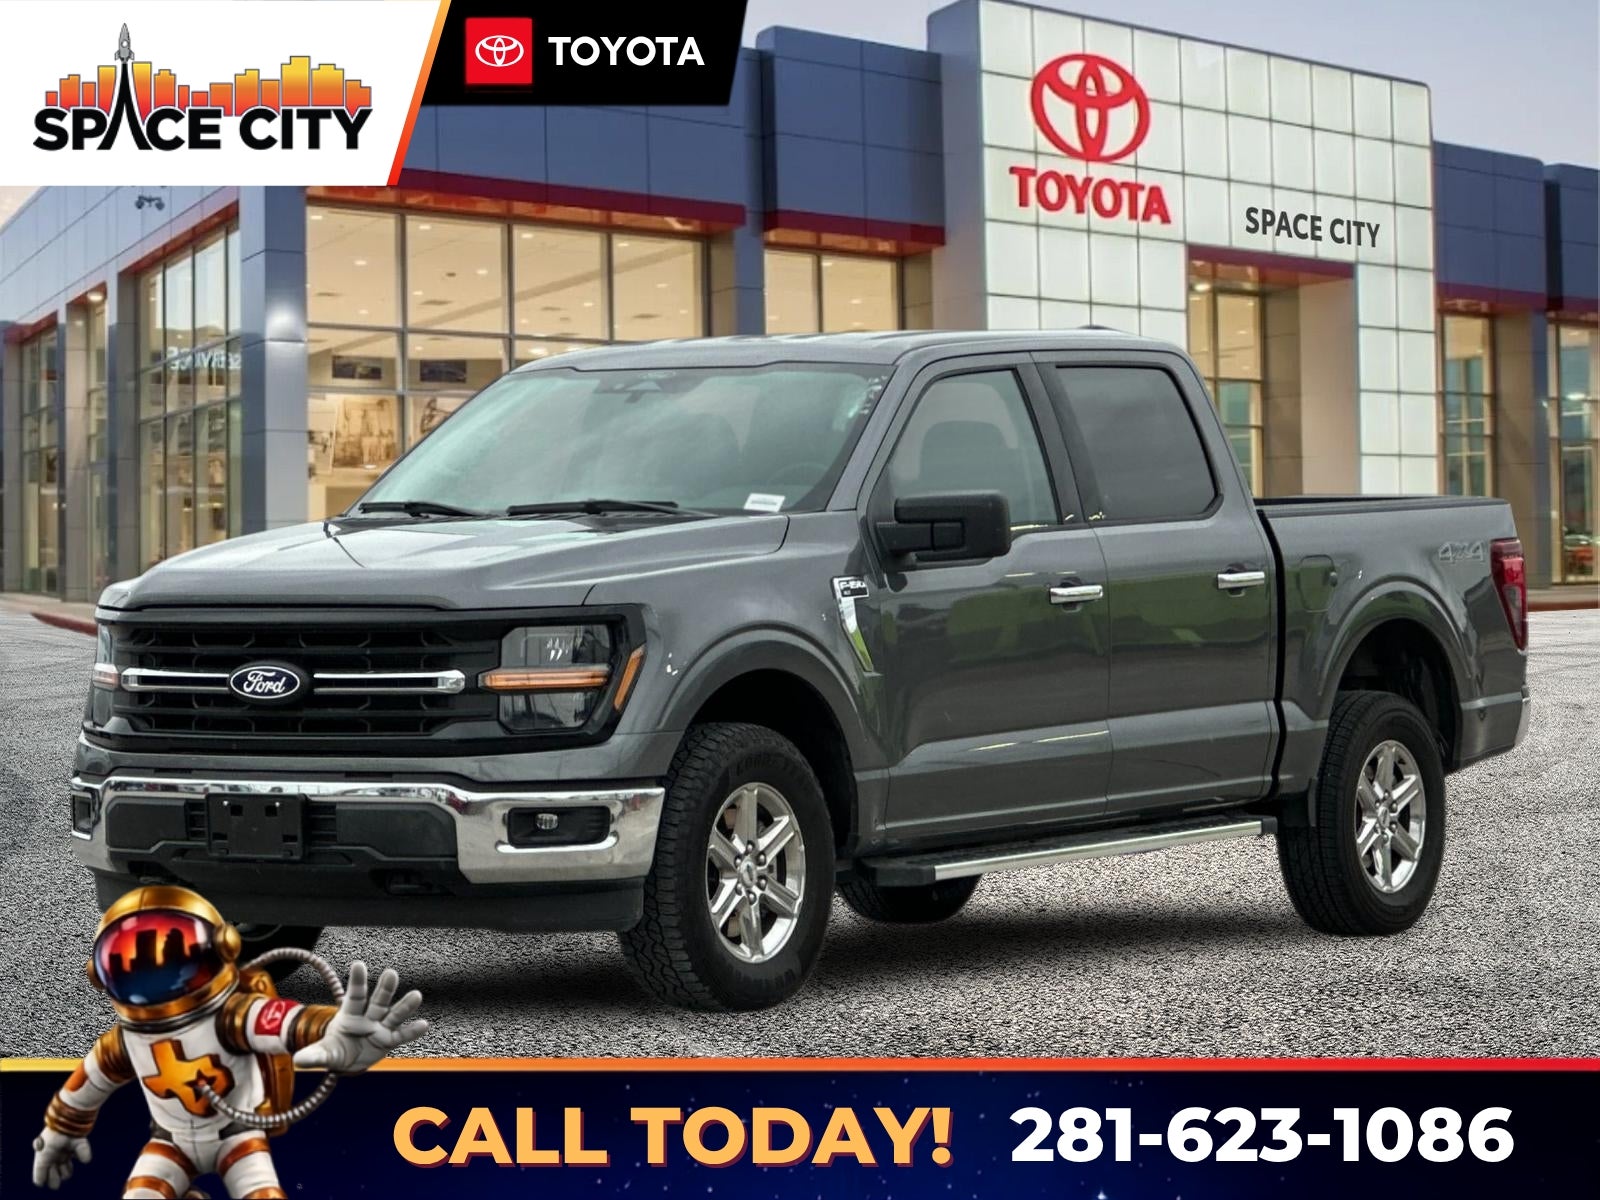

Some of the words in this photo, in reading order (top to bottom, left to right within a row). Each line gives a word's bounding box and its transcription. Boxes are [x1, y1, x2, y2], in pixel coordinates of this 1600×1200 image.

[1009, 166, 1171, 224] TOYOTA
[1245, 206, 1322, 241] SPACE
[1329, 218, 1380, 247] CITY
[243, 670, 287, 693] Ford
